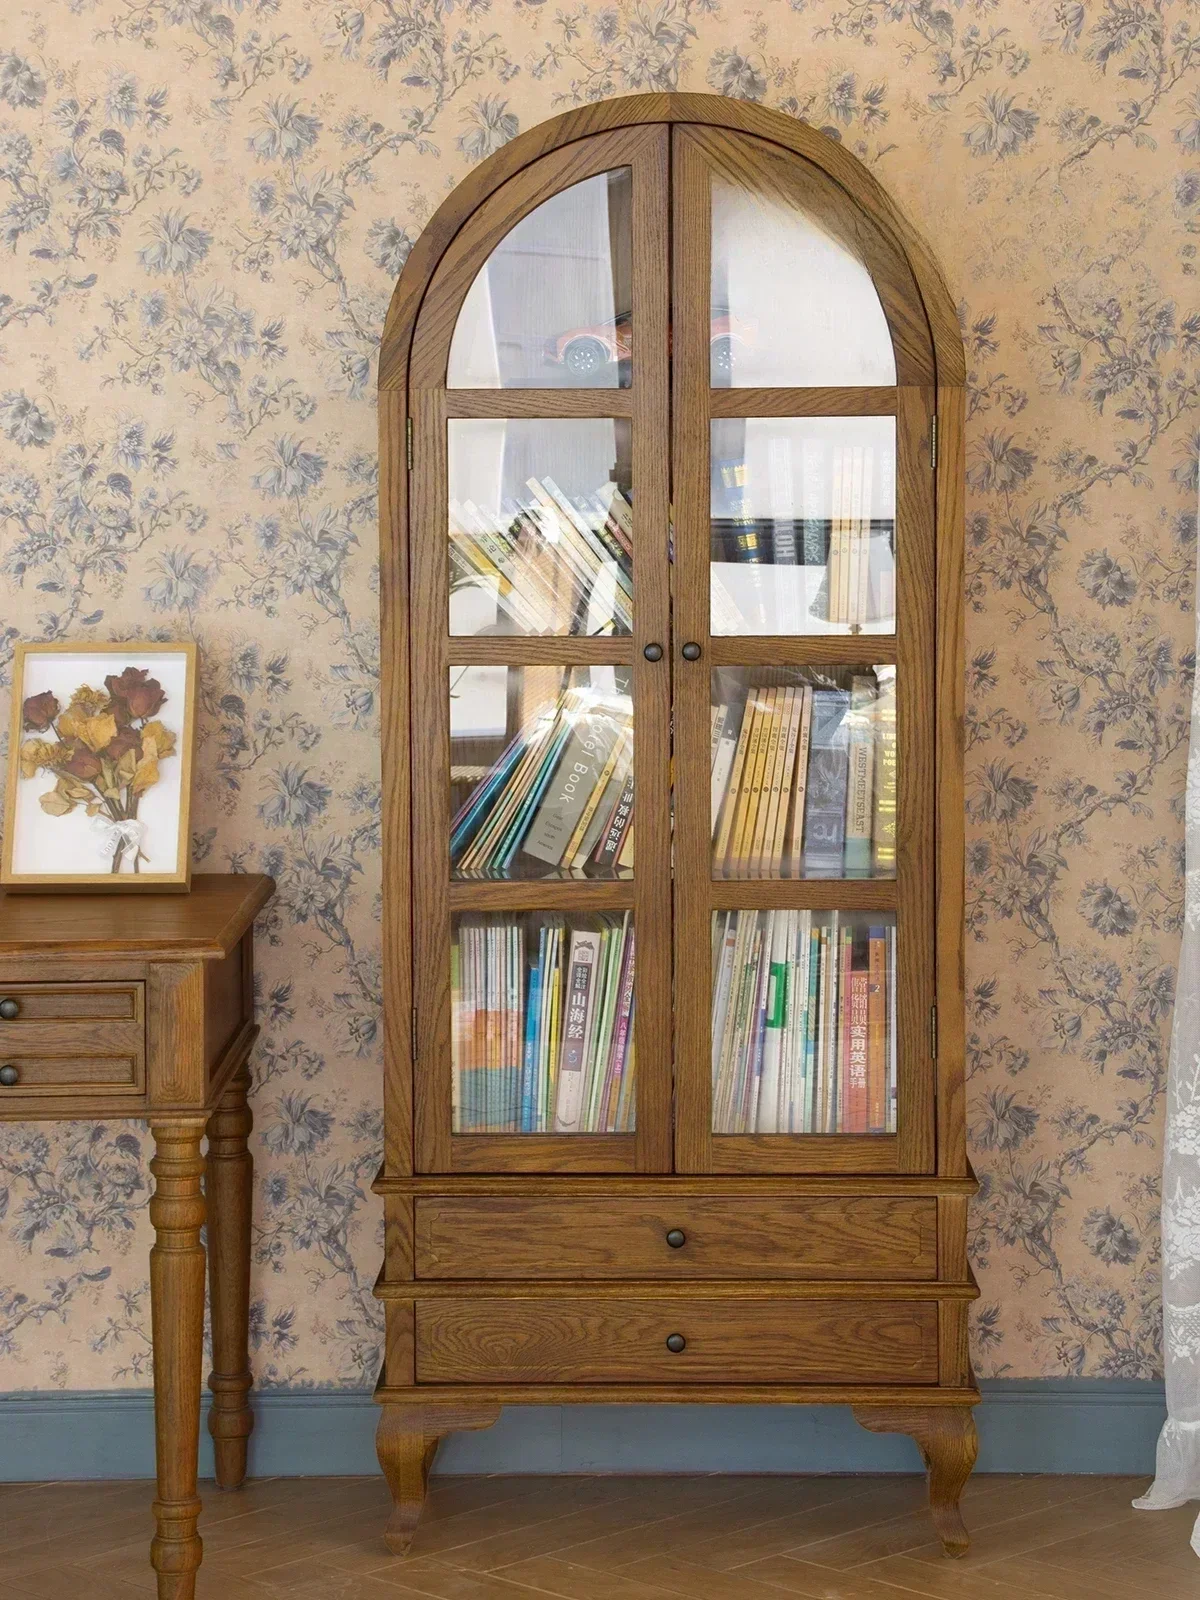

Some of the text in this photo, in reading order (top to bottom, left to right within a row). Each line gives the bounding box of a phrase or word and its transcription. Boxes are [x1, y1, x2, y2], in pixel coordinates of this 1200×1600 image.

[558, 761, 589, 803] Book
[874, 984, 880, 993] 2
[568, 992, 586, 1040] 山海经
[849, 1025, 867, 1077] 实用英语
[849, 1077, 866, 1089] 手册
